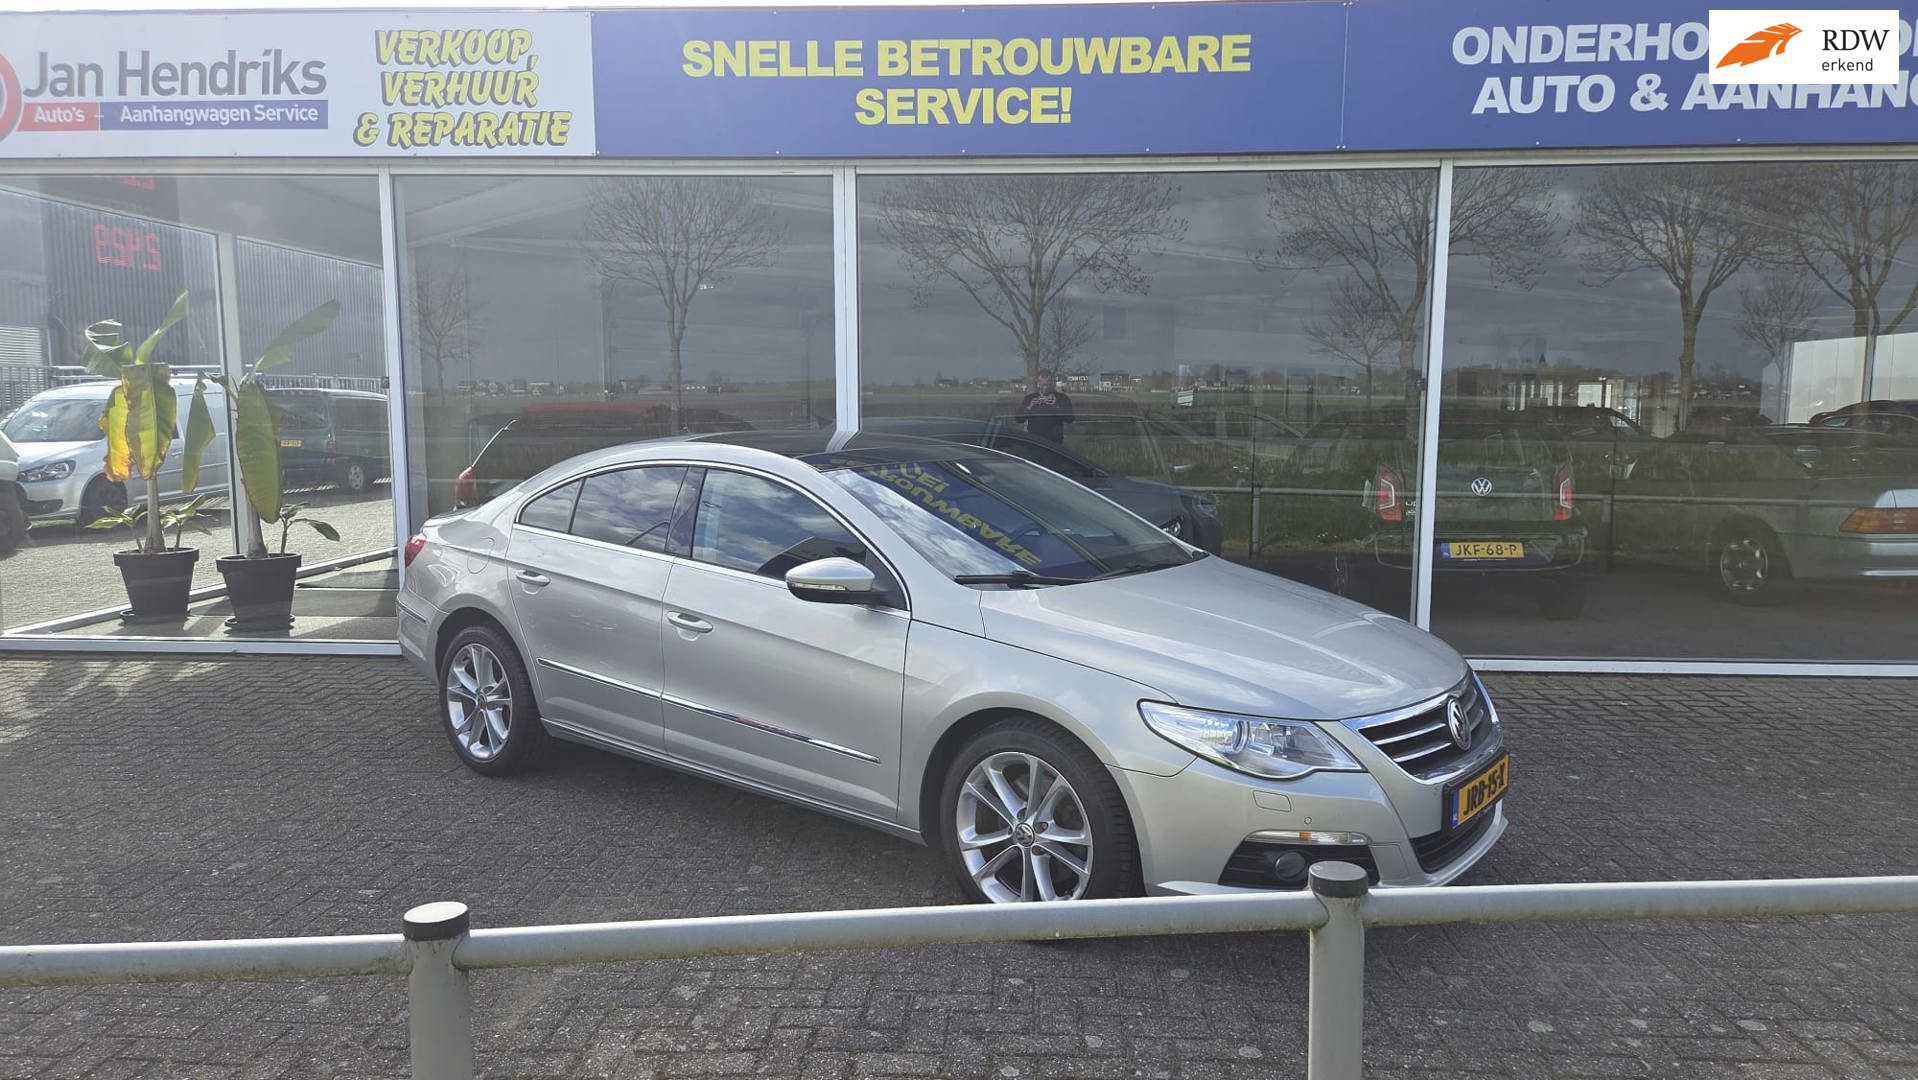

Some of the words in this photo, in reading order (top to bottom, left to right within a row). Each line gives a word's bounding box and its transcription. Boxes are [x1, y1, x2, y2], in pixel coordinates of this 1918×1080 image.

[375, 29, 538, 70] VERKOOP,
[682, 40, 863, 77] SNELLE
[877, 35, 1252, 76] BETROUWBARE
[23, 51, 104, 98] Jan
[381, 70, 539, 108] VERHUUR
[1472, 75, 1615, 114] AUTO
[1630, 73, 1669, 112] &
[1681, 72, 1918, 111] AANHAN
[34, 106, 85, 123] Auto's
[120, 105, 250, 125] Aanhangwagen
[254, 104, 318, 122] Service
[855, 87, 1072, 125] SERVICE!
[353, 112, 380, 147] &
[387, 111, 572, 149] REPARATIE
[1455, 544, 1517, 556] JKF-68-P
